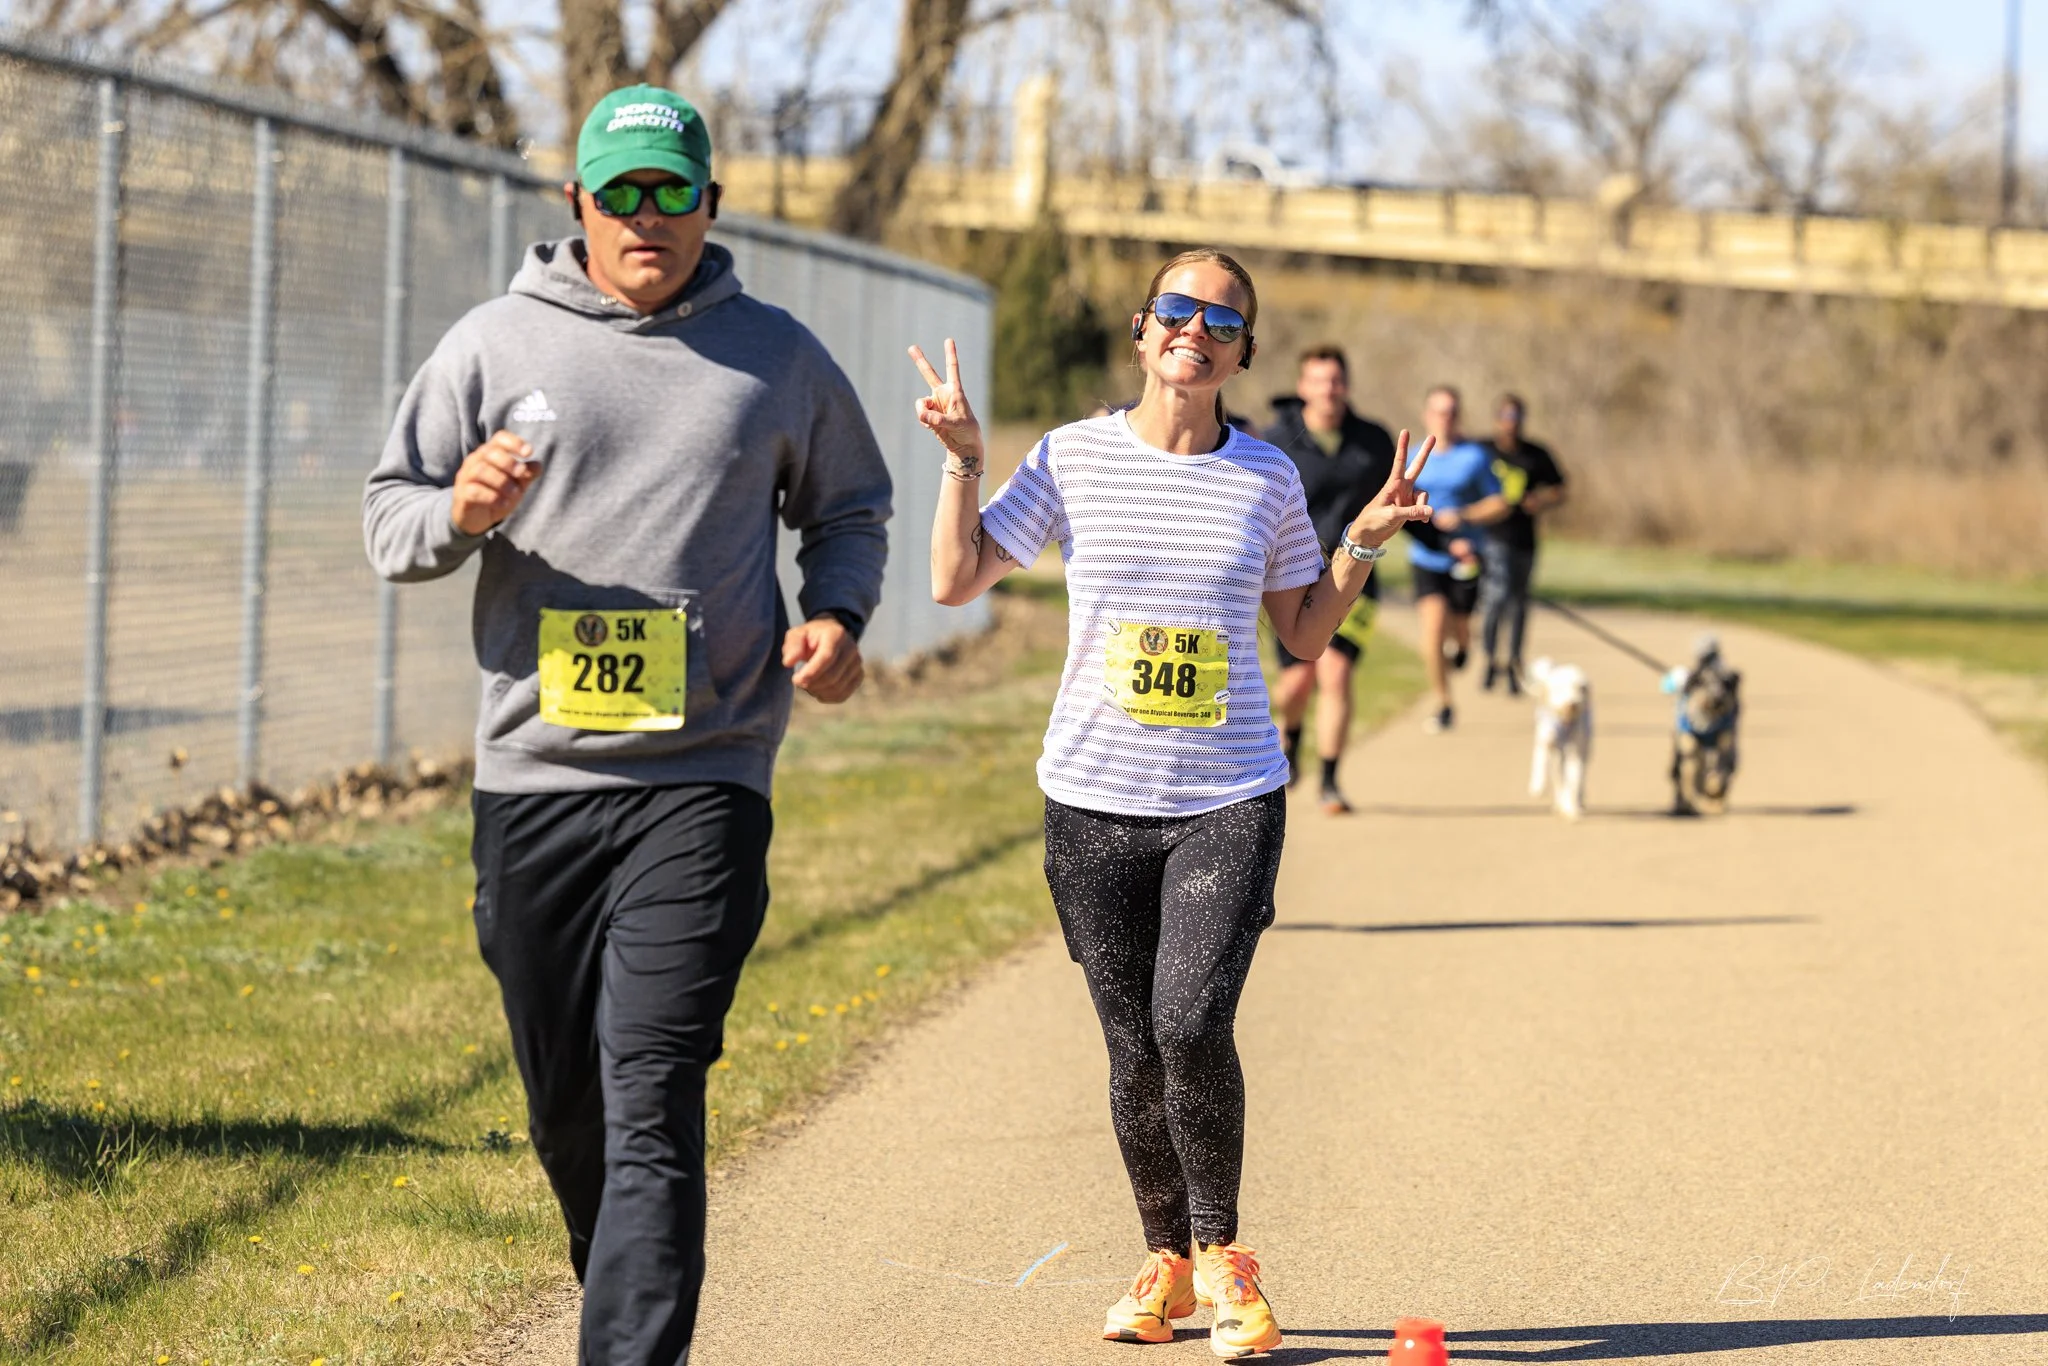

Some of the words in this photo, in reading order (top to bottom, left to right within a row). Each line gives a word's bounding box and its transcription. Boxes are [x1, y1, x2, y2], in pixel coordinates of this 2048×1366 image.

[614, 102, 679, 119] NORTH
[606, 114, 684, 133] DAKOTA
[616, 618, 647, 641] 5K
[1174, 633, 1200, 654] 5K
[572, 653, 645, 693] 282
[1132, 659, 1197, 698] 348
[1150, 708, 1173, 718] Atypical
[1173, 710, 1199, 719] Beverage
[1200, 711, 1211, 719] 348
